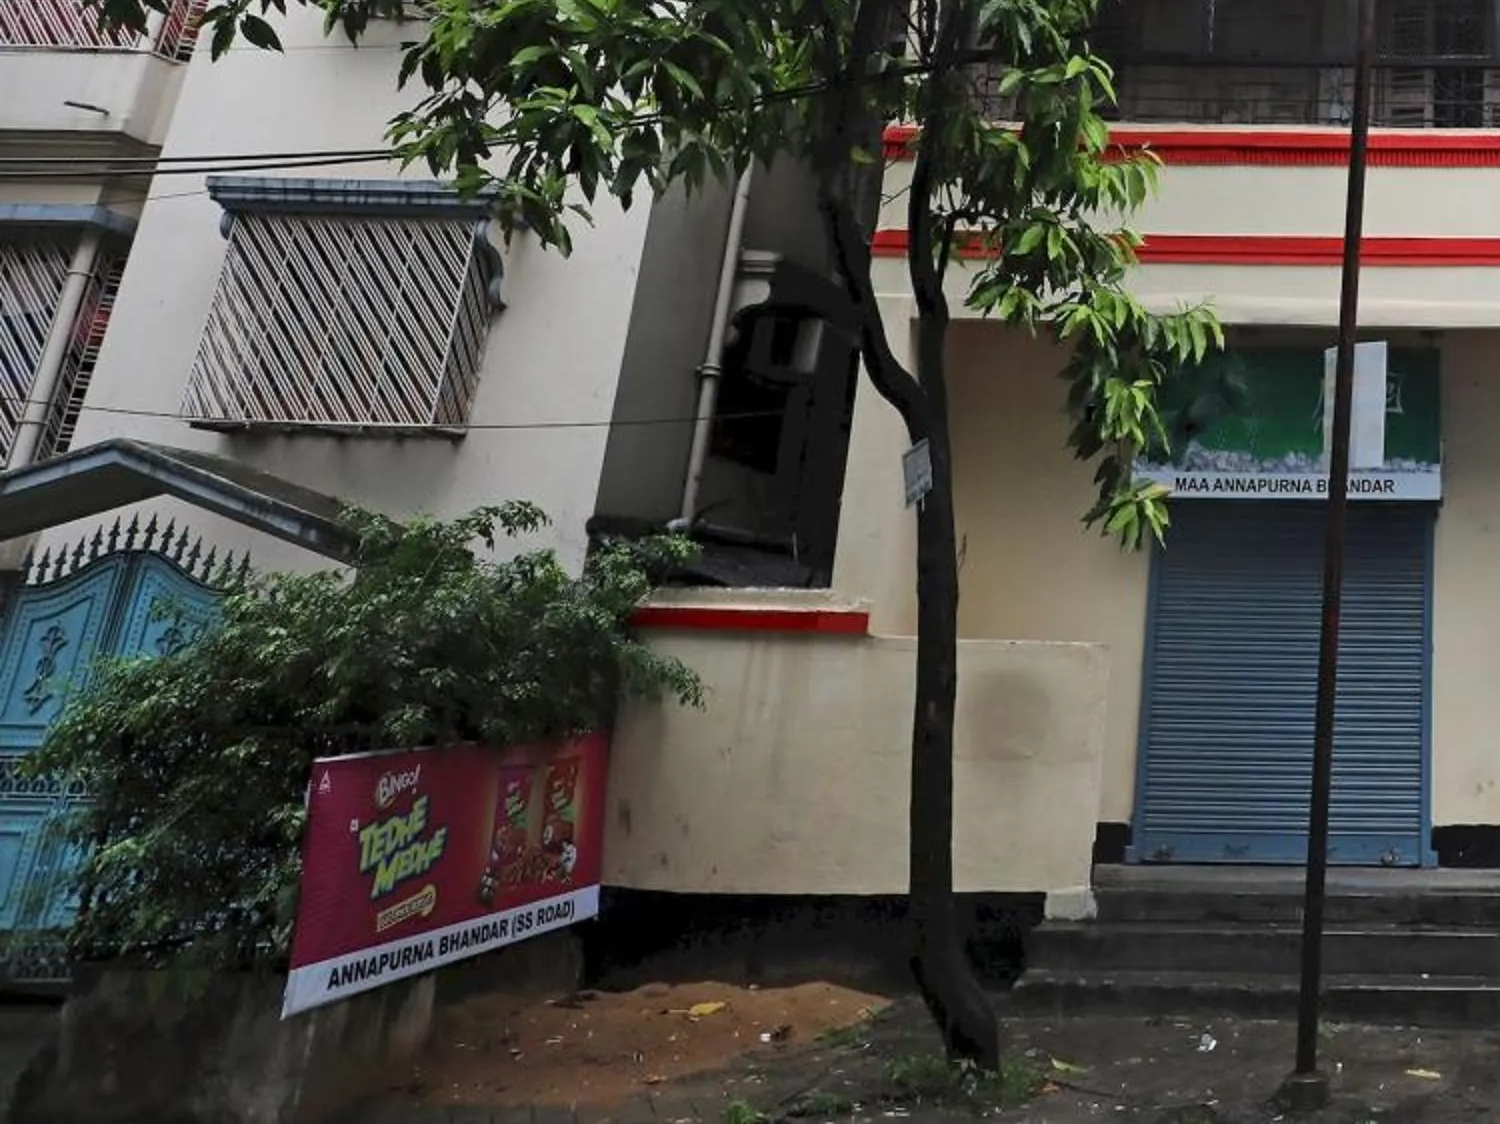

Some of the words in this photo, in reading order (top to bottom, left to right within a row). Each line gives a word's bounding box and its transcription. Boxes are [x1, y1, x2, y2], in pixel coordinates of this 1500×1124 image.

[1175, 477, 1210, 493] MAA
[1213, 477, 1313, 493] ANNAPURNA
[1316, 478, 1395, 494] BNDAR
[359, 795, 428, 873] TEDHE
[371, 828, 447, 900] MEDHE
[327, 938, 434, 990] ANNAPURNA
[439, 918, 509, 955] BHANDAR
[511, 912, 534, 939] (SS
[537, 901, 575, 927] ROAD)
